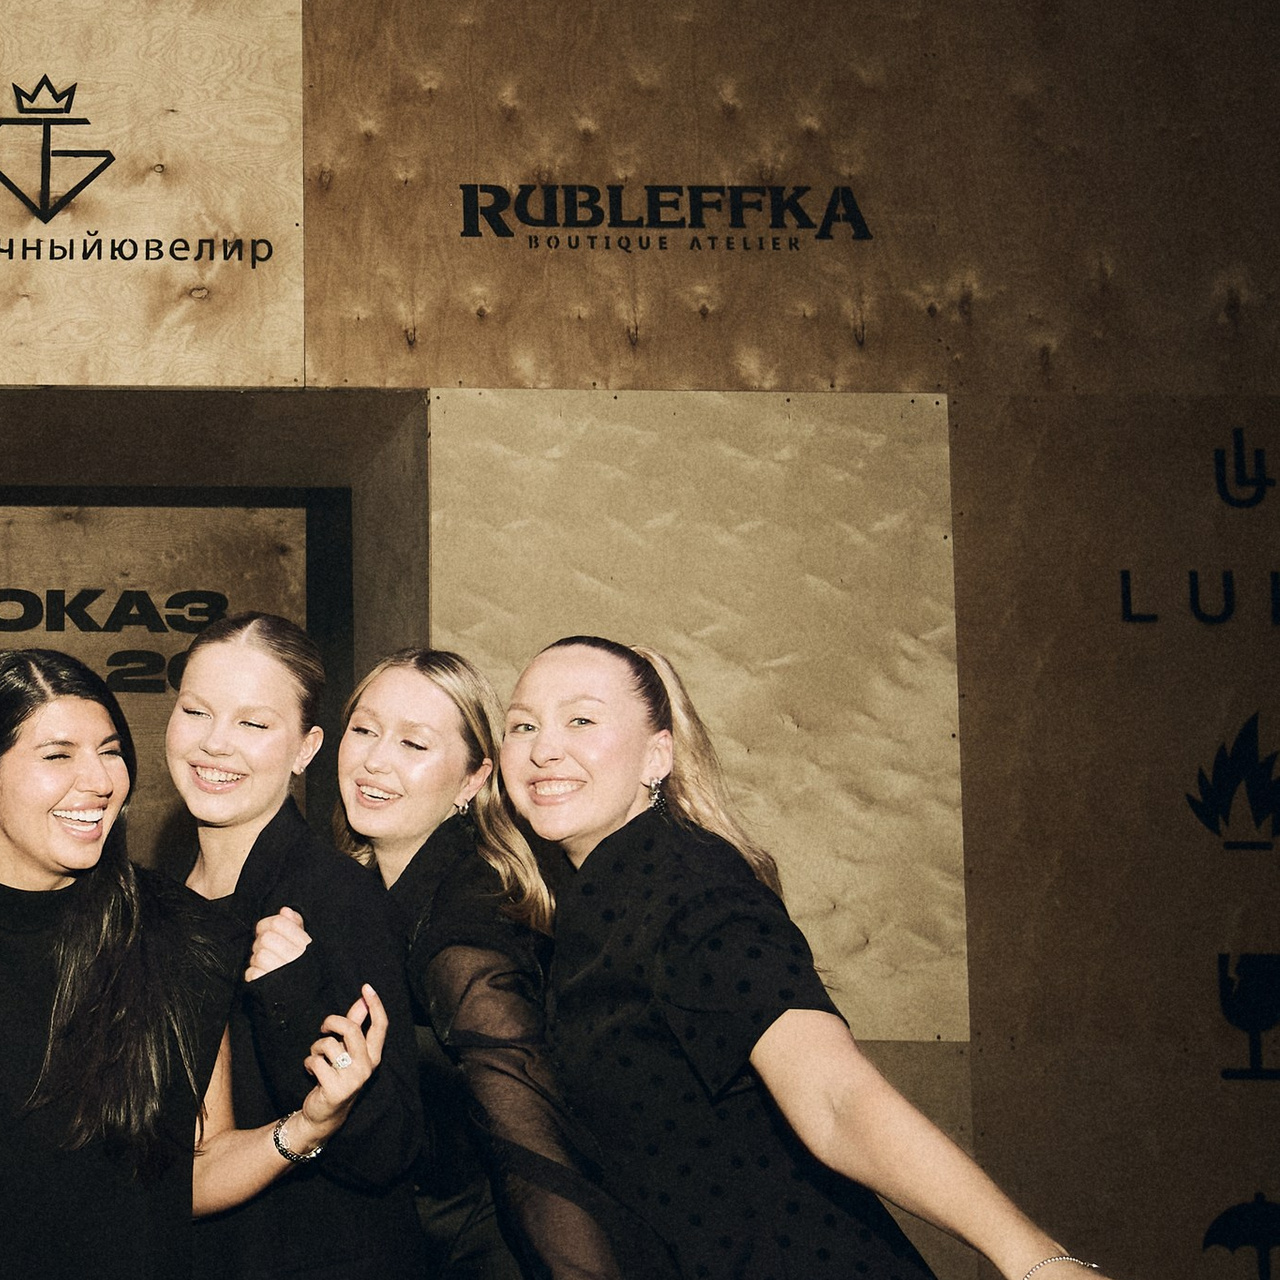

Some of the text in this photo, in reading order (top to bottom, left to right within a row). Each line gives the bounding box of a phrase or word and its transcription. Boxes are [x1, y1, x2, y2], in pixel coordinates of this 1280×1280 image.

[460, 184, 873, 239] RUBLEFFKA
[528, 235, 801, 252] BOUTIQUE ATELIER
[1120, 570, 1280, 625] LU
